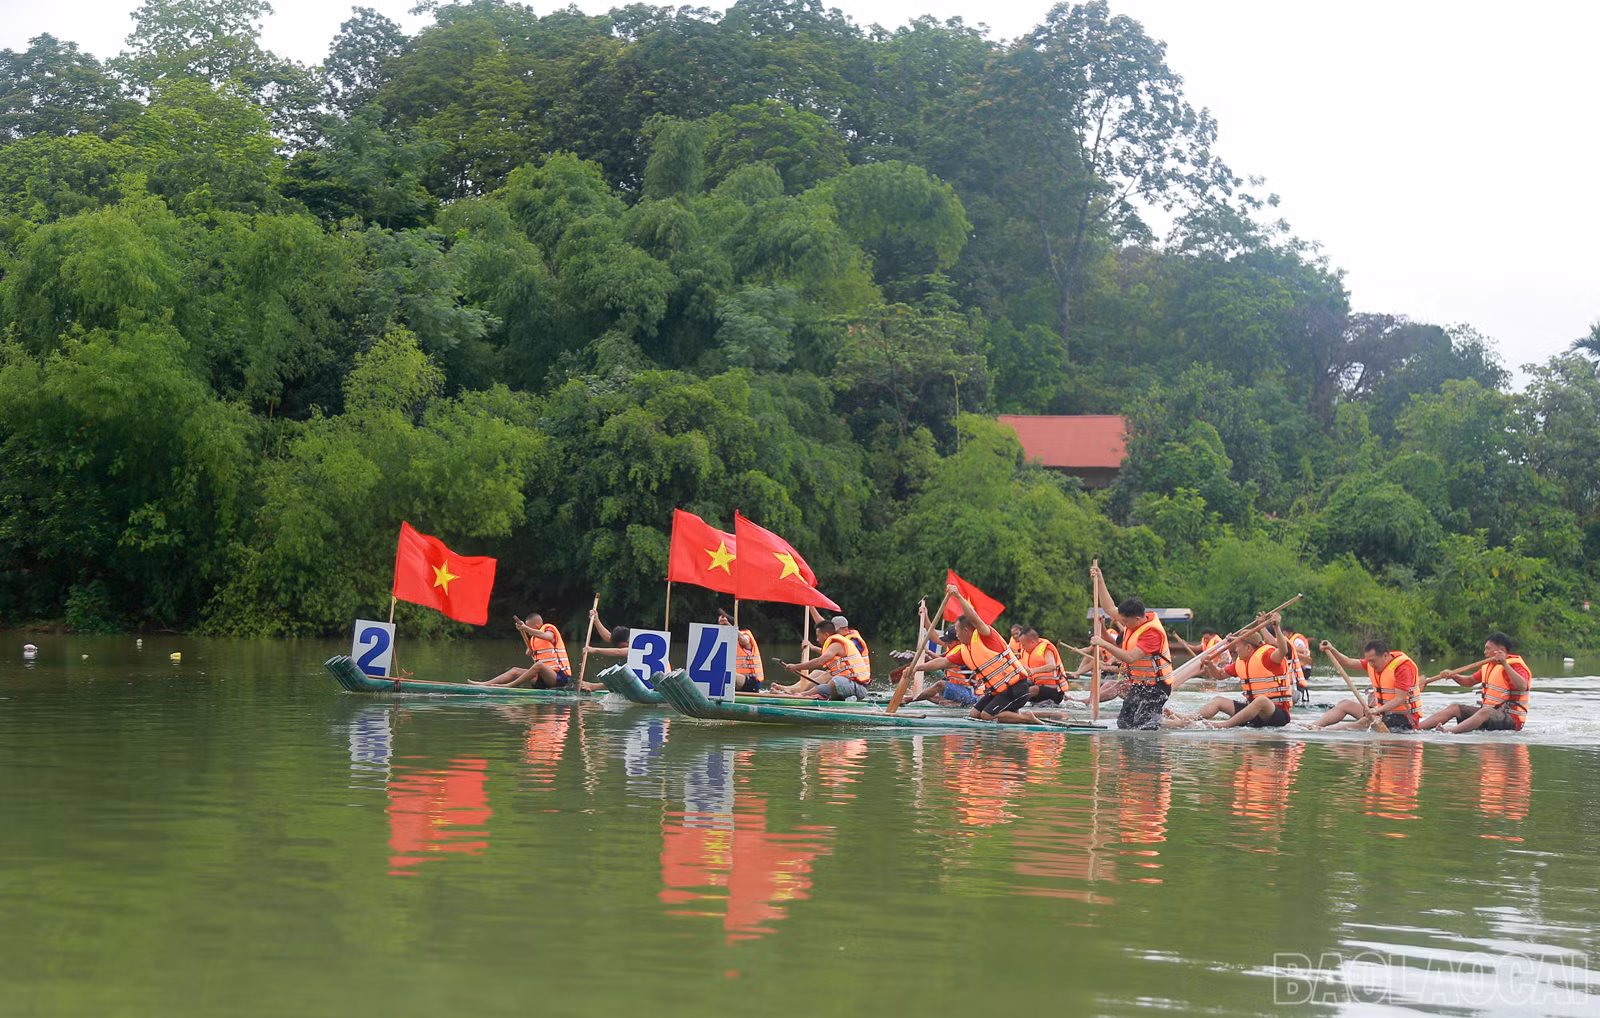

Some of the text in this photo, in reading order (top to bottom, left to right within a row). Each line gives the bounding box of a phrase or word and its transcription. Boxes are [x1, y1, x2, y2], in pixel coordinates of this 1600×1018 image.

[357, 627, 390, 676] 2
[631, 633, 667, 690] 3
[689, 627, 732, 697] 4
